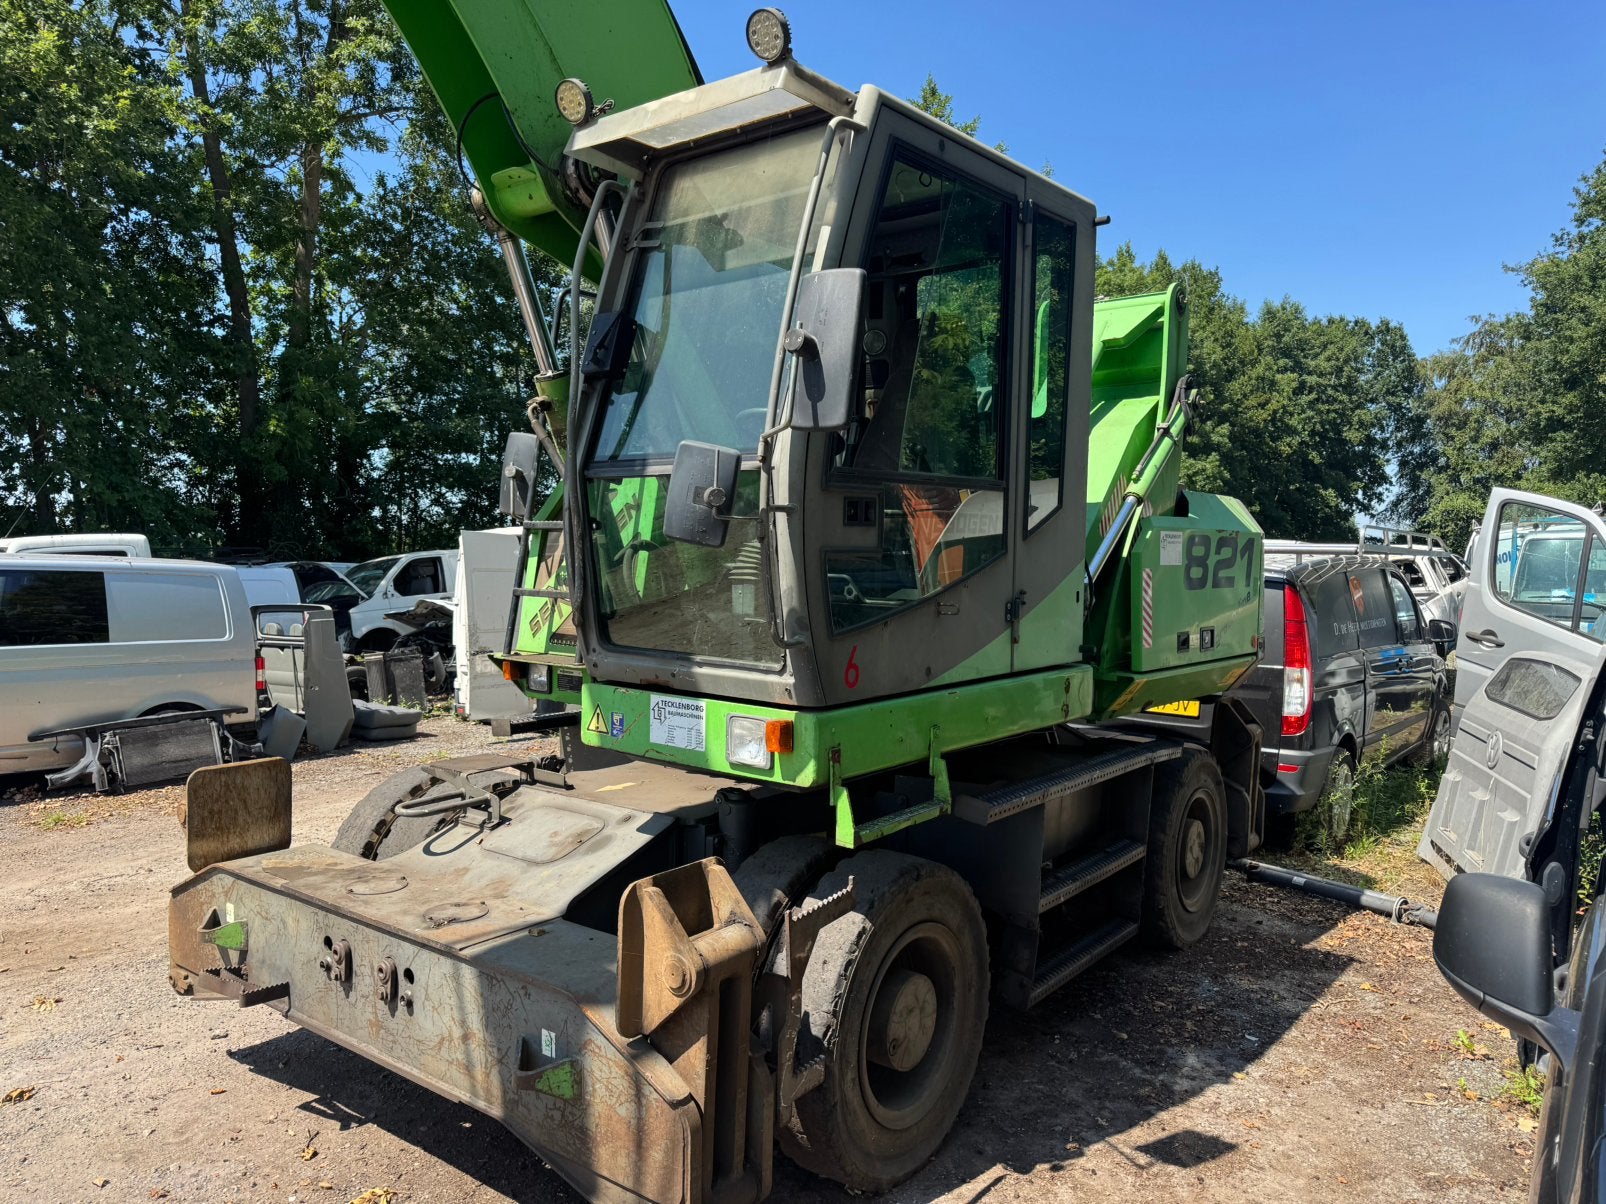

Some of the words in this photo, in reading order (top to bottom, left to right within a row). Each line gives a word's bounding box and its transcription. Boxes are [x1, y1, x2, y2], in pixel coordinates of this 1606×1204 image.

[1184, 534, 1255, 590] 821
[844, 645, 860, 689] 6
[660, 700, 704, 712] TECKLENBORG
[667, 710, 704, 720] BAUMASCHINEN
